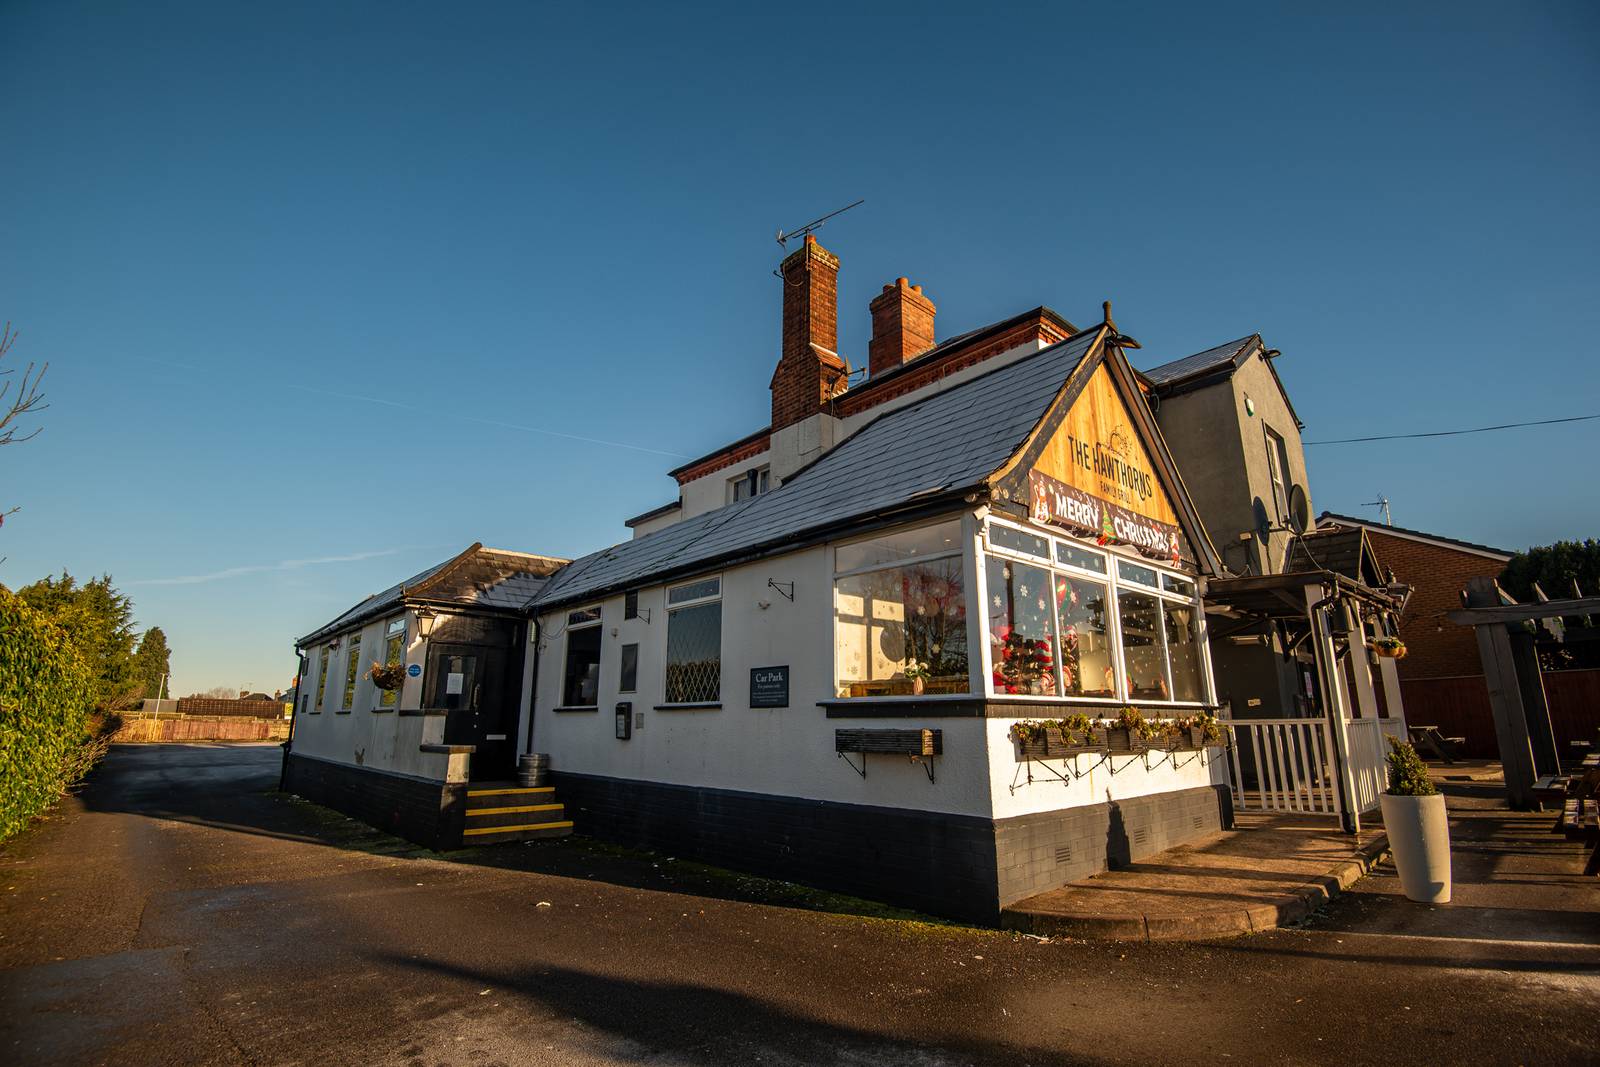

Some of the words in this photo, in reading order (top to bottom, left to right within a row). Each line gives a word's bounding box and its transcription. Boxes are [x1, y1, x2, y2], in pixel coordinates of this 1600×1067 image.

[1068, 435, 1091, 470] THE
[1092, 441, 1152, 500] HAWTHORNS
[1055, 492, 1099, 529] MERRY
[1113, 516, 1170, 551] CHRISTMAS
[755, 673, 767, 683] Car
[768, 672, 784, 682] Park
